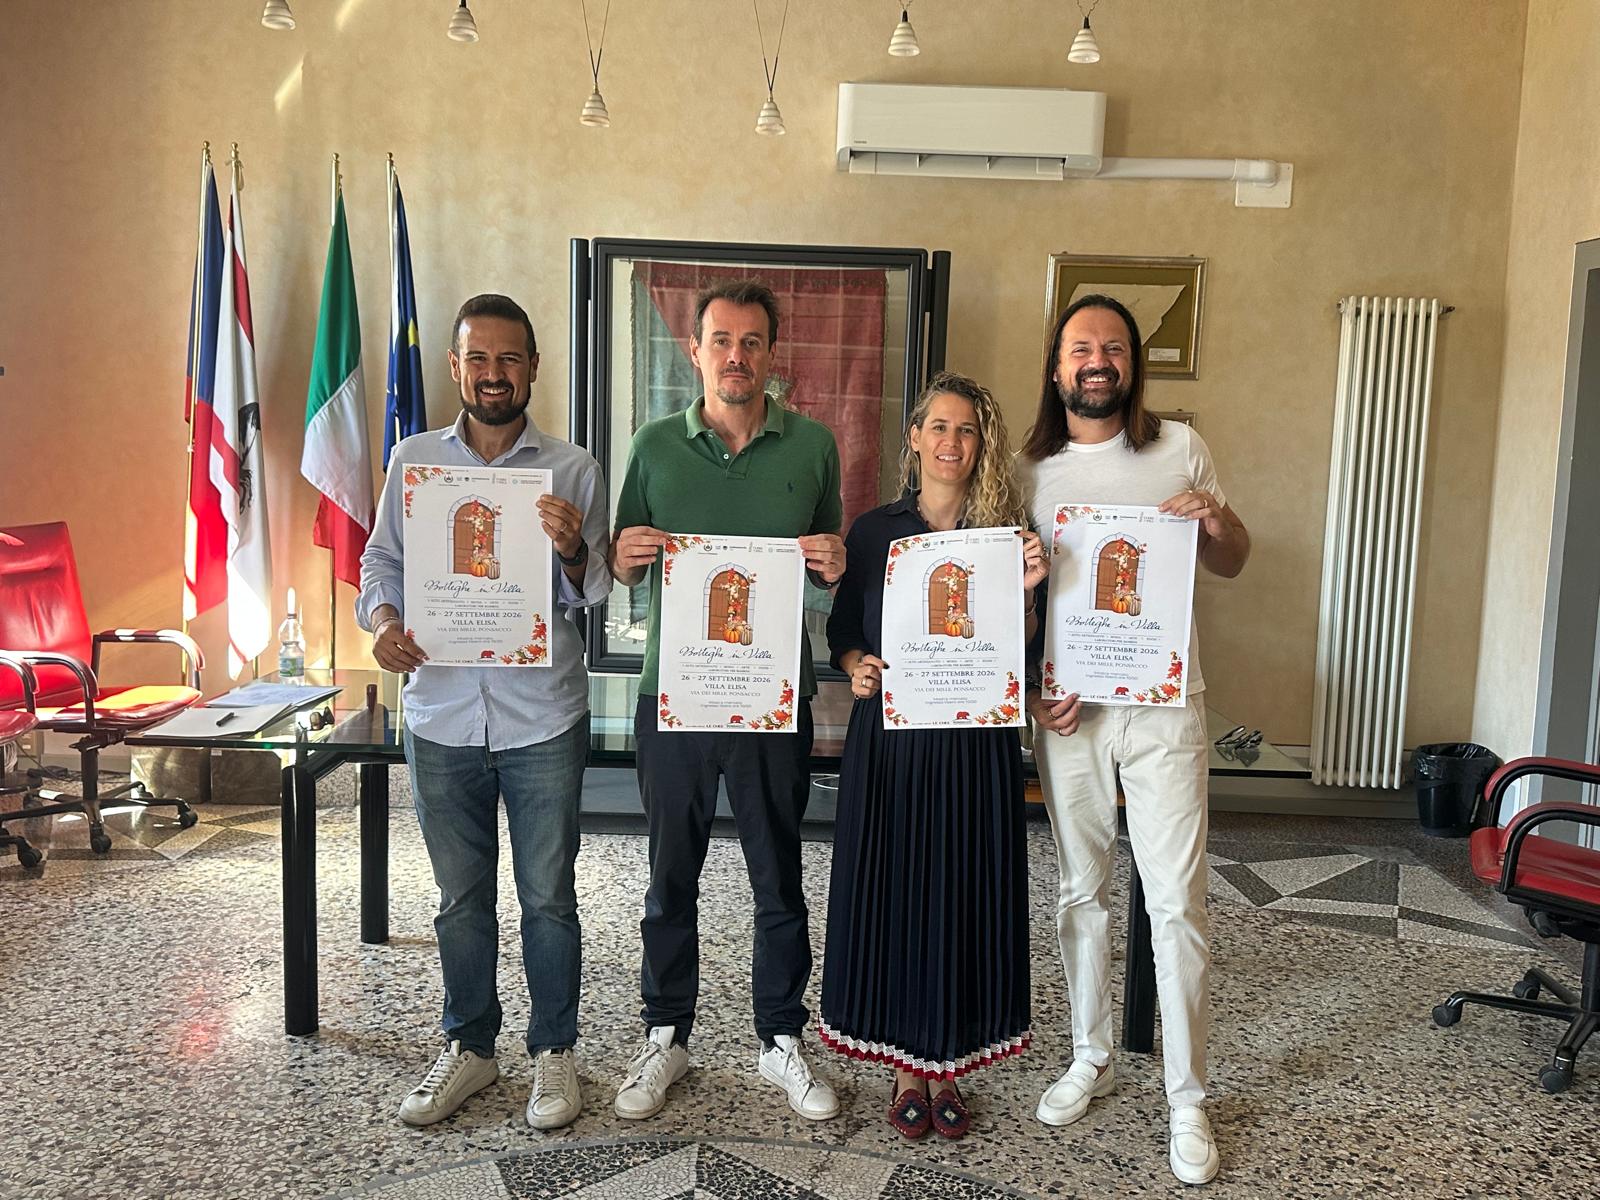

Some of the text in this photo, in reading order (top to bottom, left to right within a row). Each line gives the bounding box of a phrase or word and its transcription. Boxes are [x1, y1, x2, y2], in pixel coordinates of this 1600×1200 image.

[424, 580, 524, 598] Botteghe in Villa
[1065, 616, 1164, 633] Botteghe in Villa
[679, 646, 774, 663] Botteghe in Villa
[901, 641, 997, 659] Botteghe in Villa
